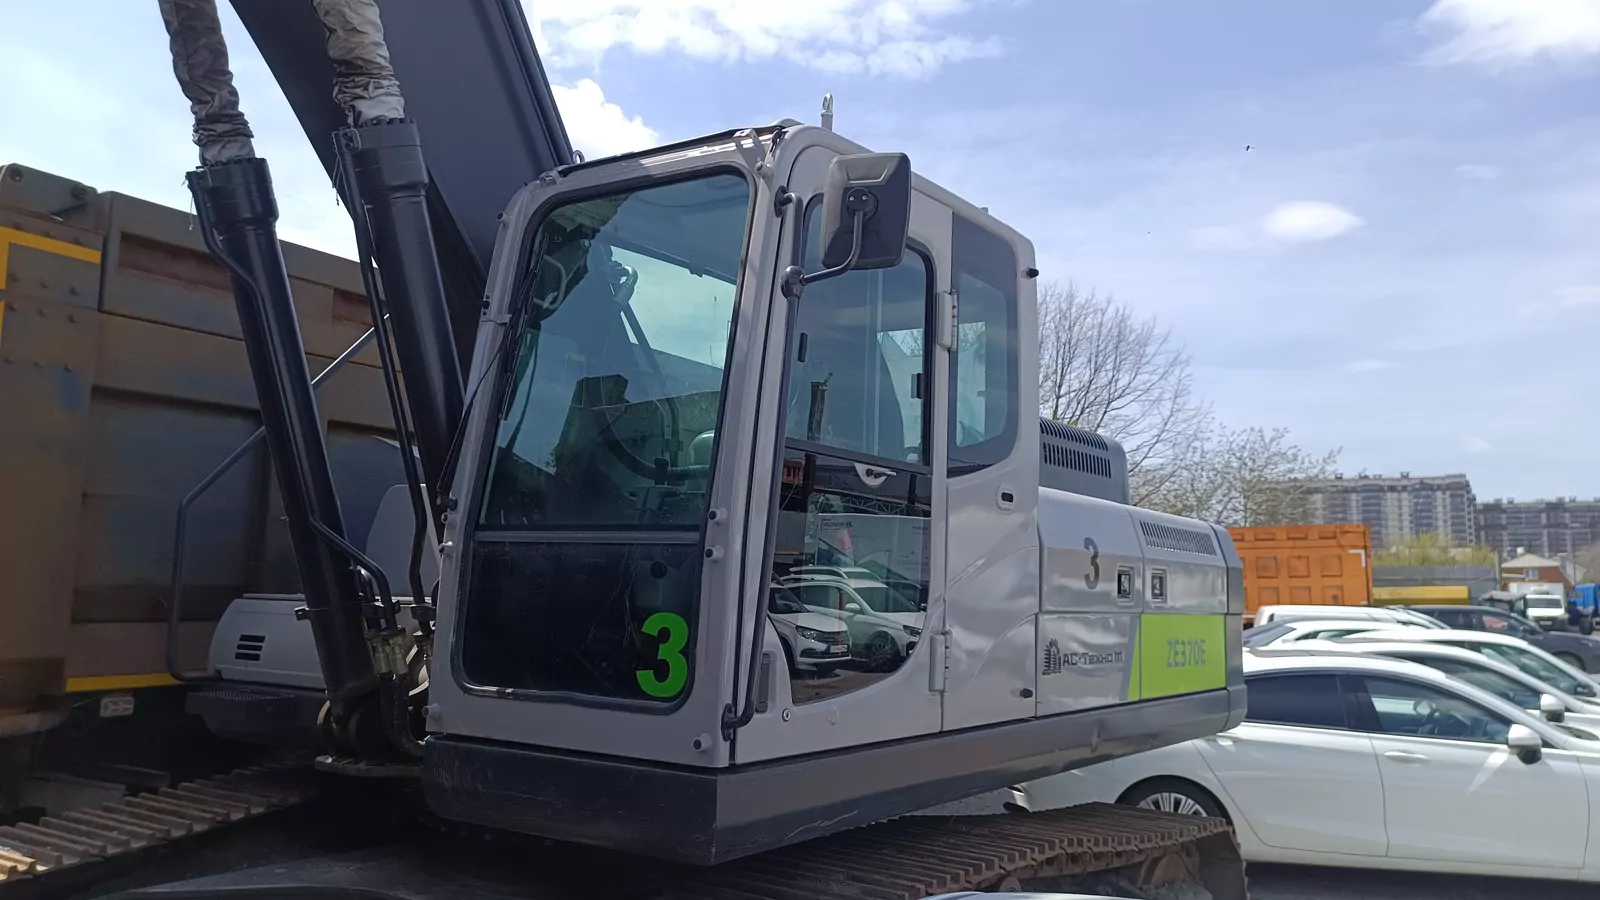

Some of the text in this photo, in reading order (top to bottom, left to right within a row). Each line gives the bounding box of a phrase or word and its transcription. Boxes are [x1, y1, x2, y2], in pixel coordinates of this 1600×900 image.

[1084, 537, 1100, 590] 3
[635, 612, 689, 698] 3
[1166, 637, 1206, 668] ZE370E
